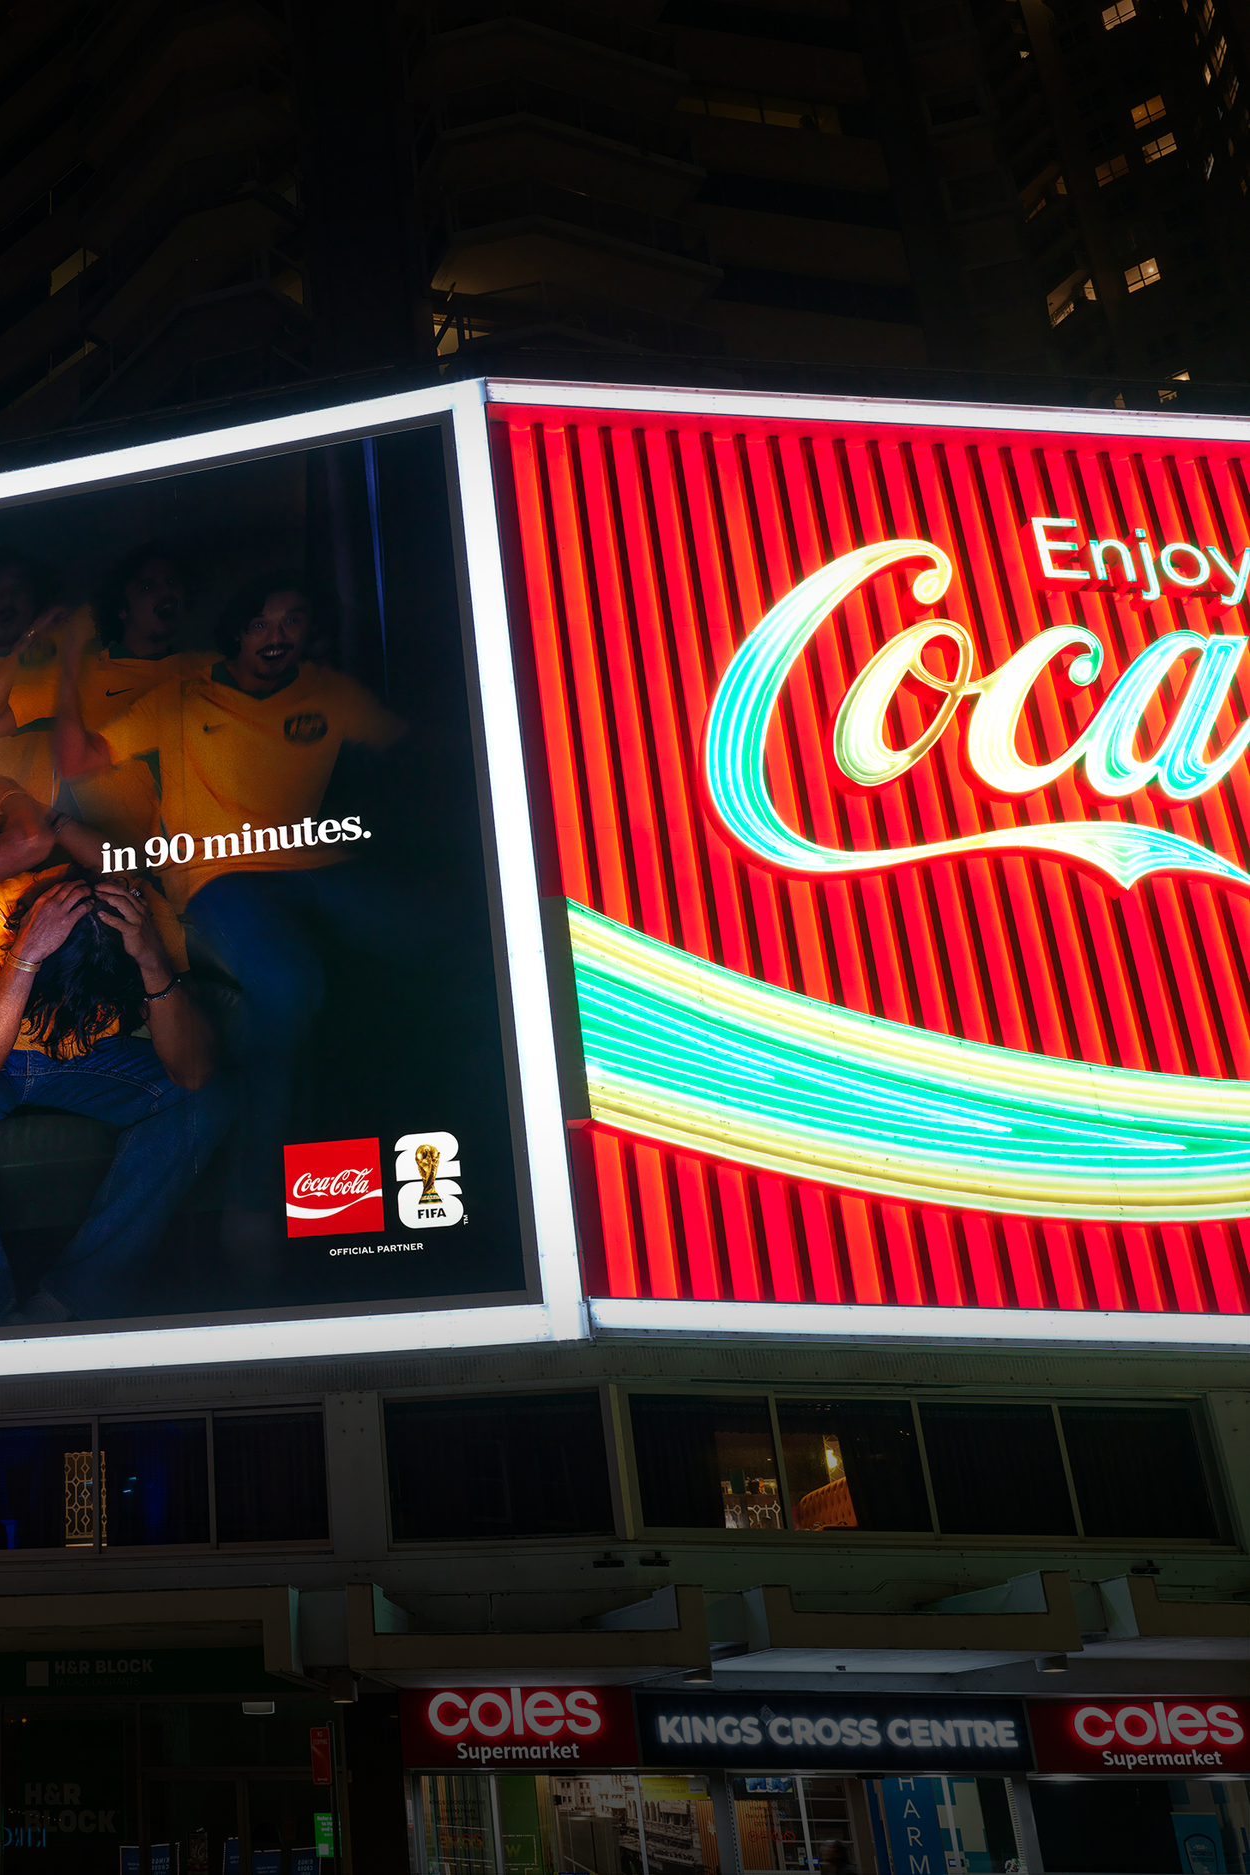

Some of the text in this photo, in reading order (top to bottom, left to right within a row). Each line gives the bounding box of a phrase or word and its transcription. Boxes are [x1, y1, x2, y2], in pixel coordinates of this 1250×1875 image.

[1030, 516, 1250, 605] Enjoy
[101, 815, 372, 874] in 90 minutes.
[292, 1167, 374, 1199] Coca-Cola
[417, 1207, 447, 1220] FIFA
[329, 1242, 424, 1257] OFFICIAL PARTNER
[54, 1659, 154, 1675] H&R BLOCK
[55, 1676, 140, 1686] TAX ACCOUNTANTS
[428, 1688, 602, 1737] coles
[1073, 1701, 1245, 1746] coles
[657, 1715, 1019, 1748] KINGS CROSS CENTRE
[456, 1741, 581, 1764] Supermarket
[1101, 1749, 1224, 1770] Supermarket
[24, 1782, 82, 1806] H&R
[24, 1810, 117, 1834] BLOCK
